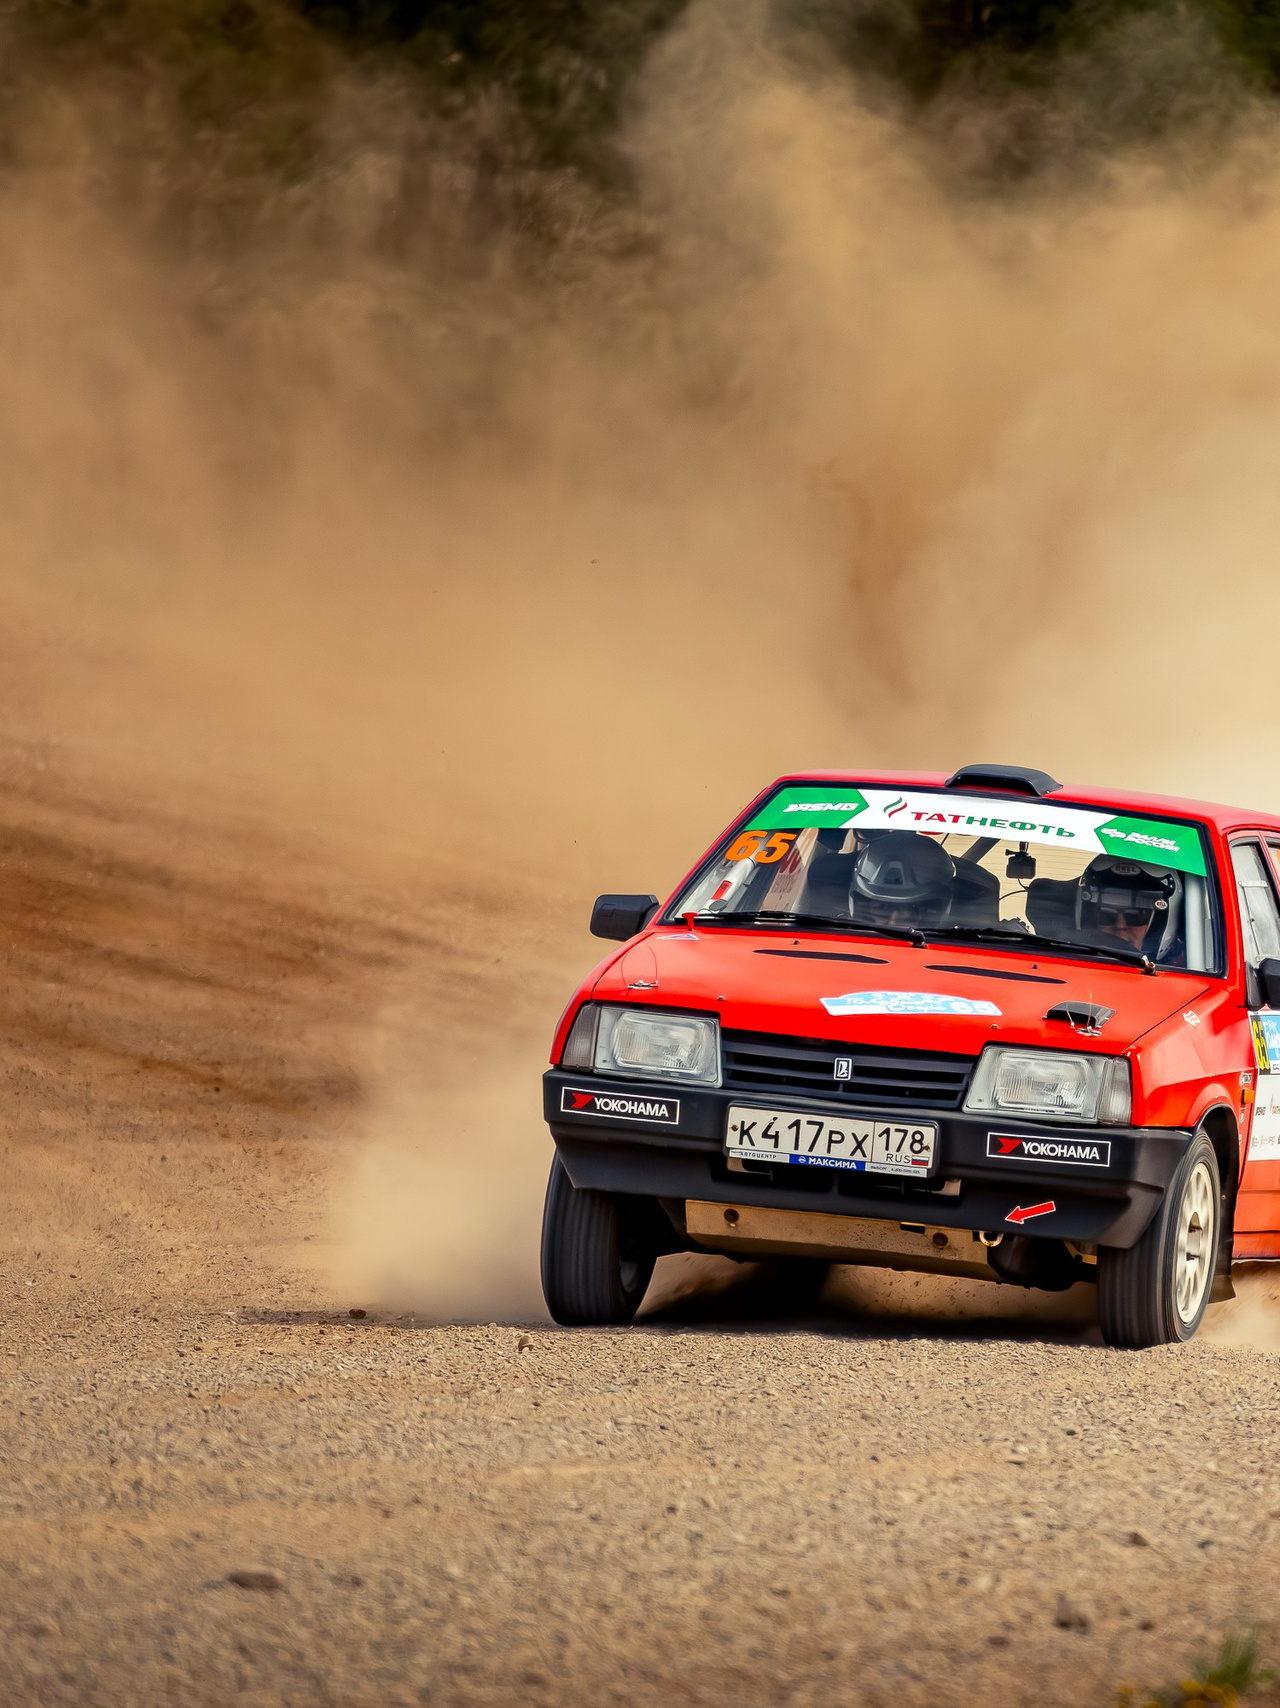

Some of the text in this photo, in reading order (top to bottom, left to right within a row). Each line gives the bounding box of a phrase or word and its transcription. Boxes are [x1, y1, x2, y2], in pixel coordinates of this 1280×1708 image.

[911, 811, 1076, 838] ТАТНЕФТЬ
[725, 830, 797, 864] 65
[951, 1001, 996, 1014] 65
[1252, 1020, 1270, 1070] 65
[594, 1097, 669, 1117] YOKOHAMA
[878, 1127, 928, 1154] 178
[740, 1151, 778, 1159] АВТОЦЕНТР
[886, 1153, 911, 1164] RUS
[1022, 1141, 1100, 1160] YOKOHAMA
[808, 1157, 858, 1170] МАКСИМА
